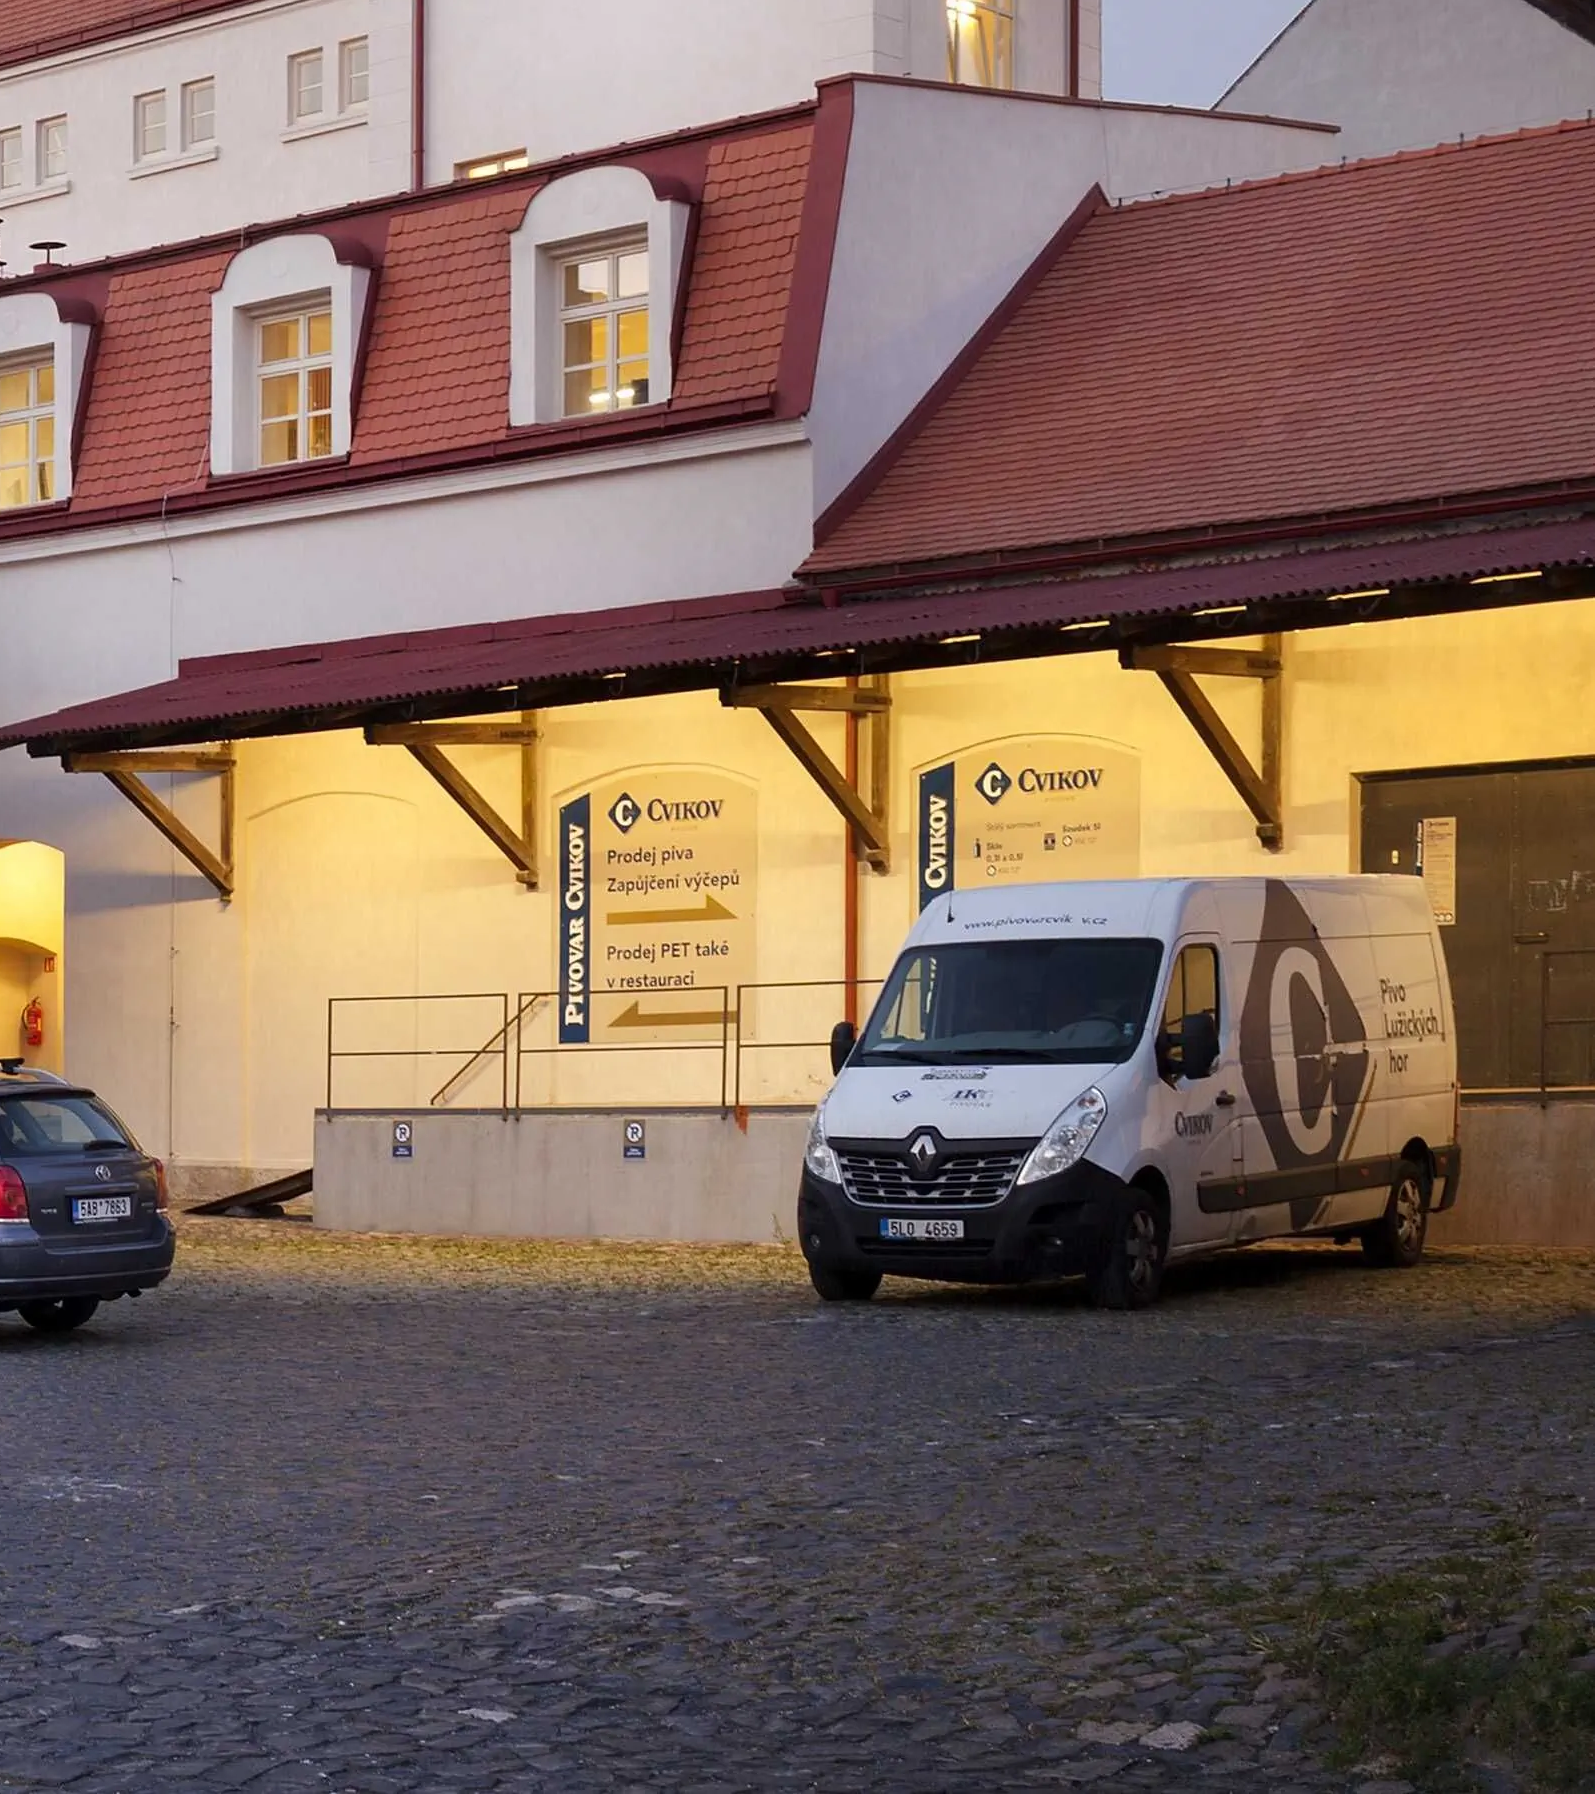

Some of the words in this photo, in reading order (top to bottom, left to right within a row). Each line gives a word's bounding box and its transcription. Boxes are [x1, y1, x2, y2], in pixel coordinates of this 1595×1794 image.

[1018, 768, 1104, 792] CVIKOV
[647, 798, 725, 822] CVIKOV
[924, 795, 947, 889] CVIKOV
[565, 823, 585, 911] CVIKOV
[607, 847, 656, 866] Prodej
[661, 846, 694, 866] piva
[607, 874, 680, 895] Zapůjčení
[684, 869, 740, 892] výčepů
[607, 944, 656, 963] Prodej
[661, 942, 691, 958] PET
[695, 940, 729, 957] také
[565, 916, 585, 1026] PIVOVAR
[607, 978, 615, 988] v
[620, 970, 695, 988] restauraci
[1379, 978, 1406, 1004] Pivo
[1384, 1007, 1439, 1042] Lužických
[1389, 1048, 1408, 1074] hor
[925, 1221, 958, 1237] 4659
